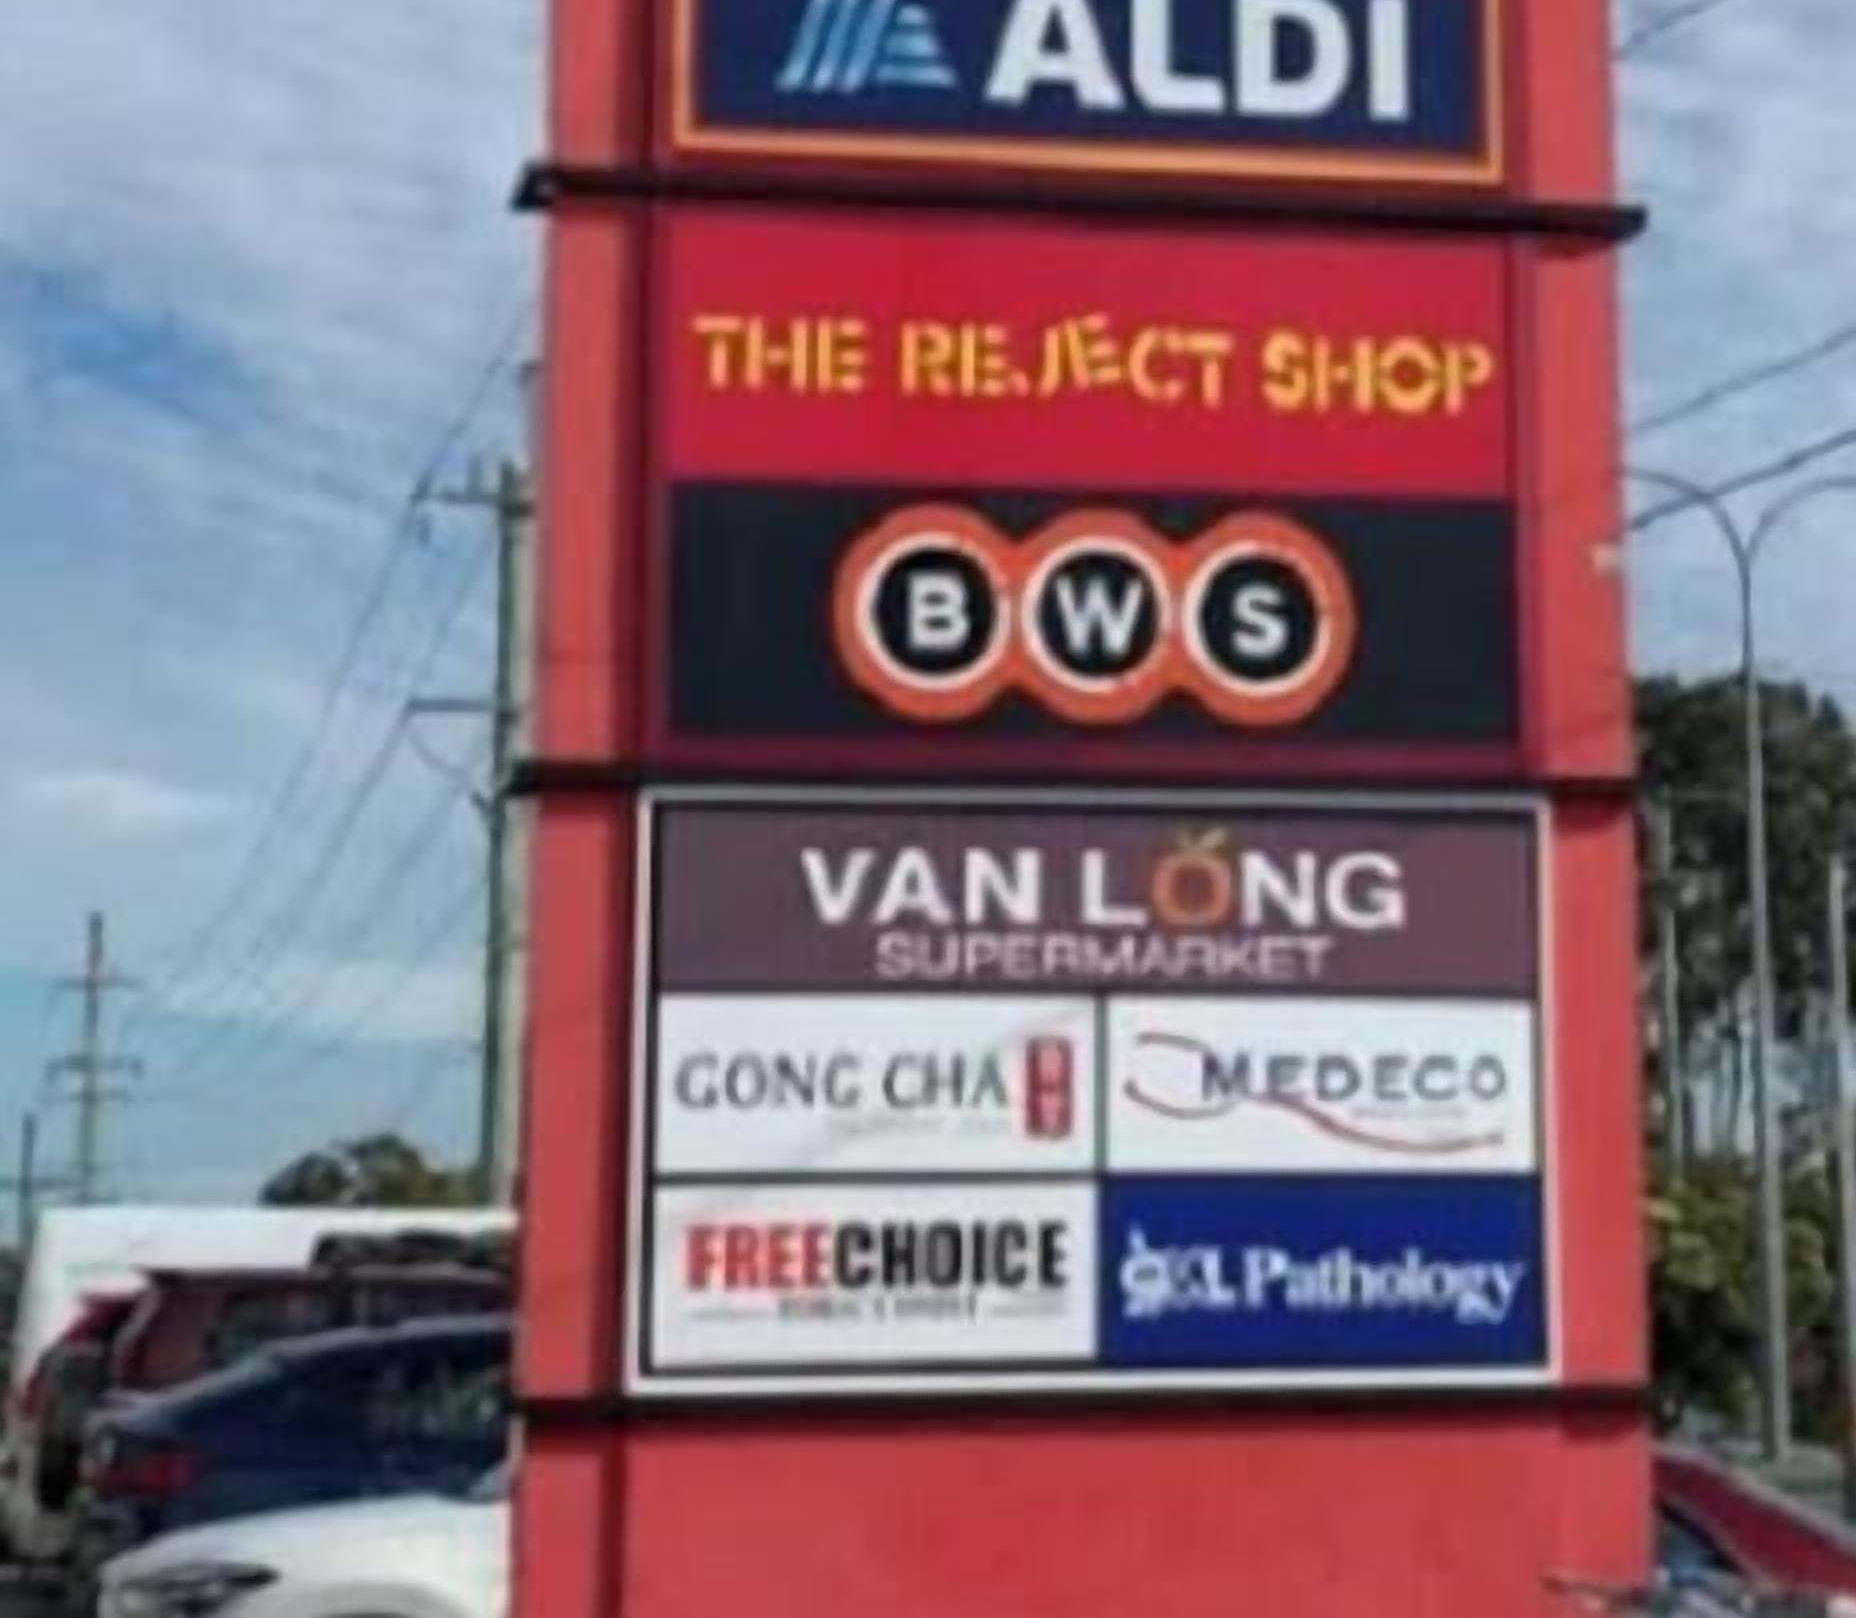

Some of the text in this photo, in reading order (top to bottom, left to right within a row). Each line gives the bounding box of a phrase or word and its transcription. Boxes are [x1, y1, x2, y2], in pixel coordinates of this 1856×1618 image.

[691, 312, 1496, 415] THE REJECT SHOP
[906, 572, 1291, 658] BWS
[800, 844, 1408, 930] VAN LONG
[874, 932, 1335, 981] SUPERMARKET
[674, 1051, 862, 1111] GONG
[882, 1051, 1010, 1111] CHA
[1200, 1052, 1508, 1103] MEDECO
[685, 1218, 1070, 1292] FREECHOICE
[1241, 1244, 1527, 1325] Pathology
